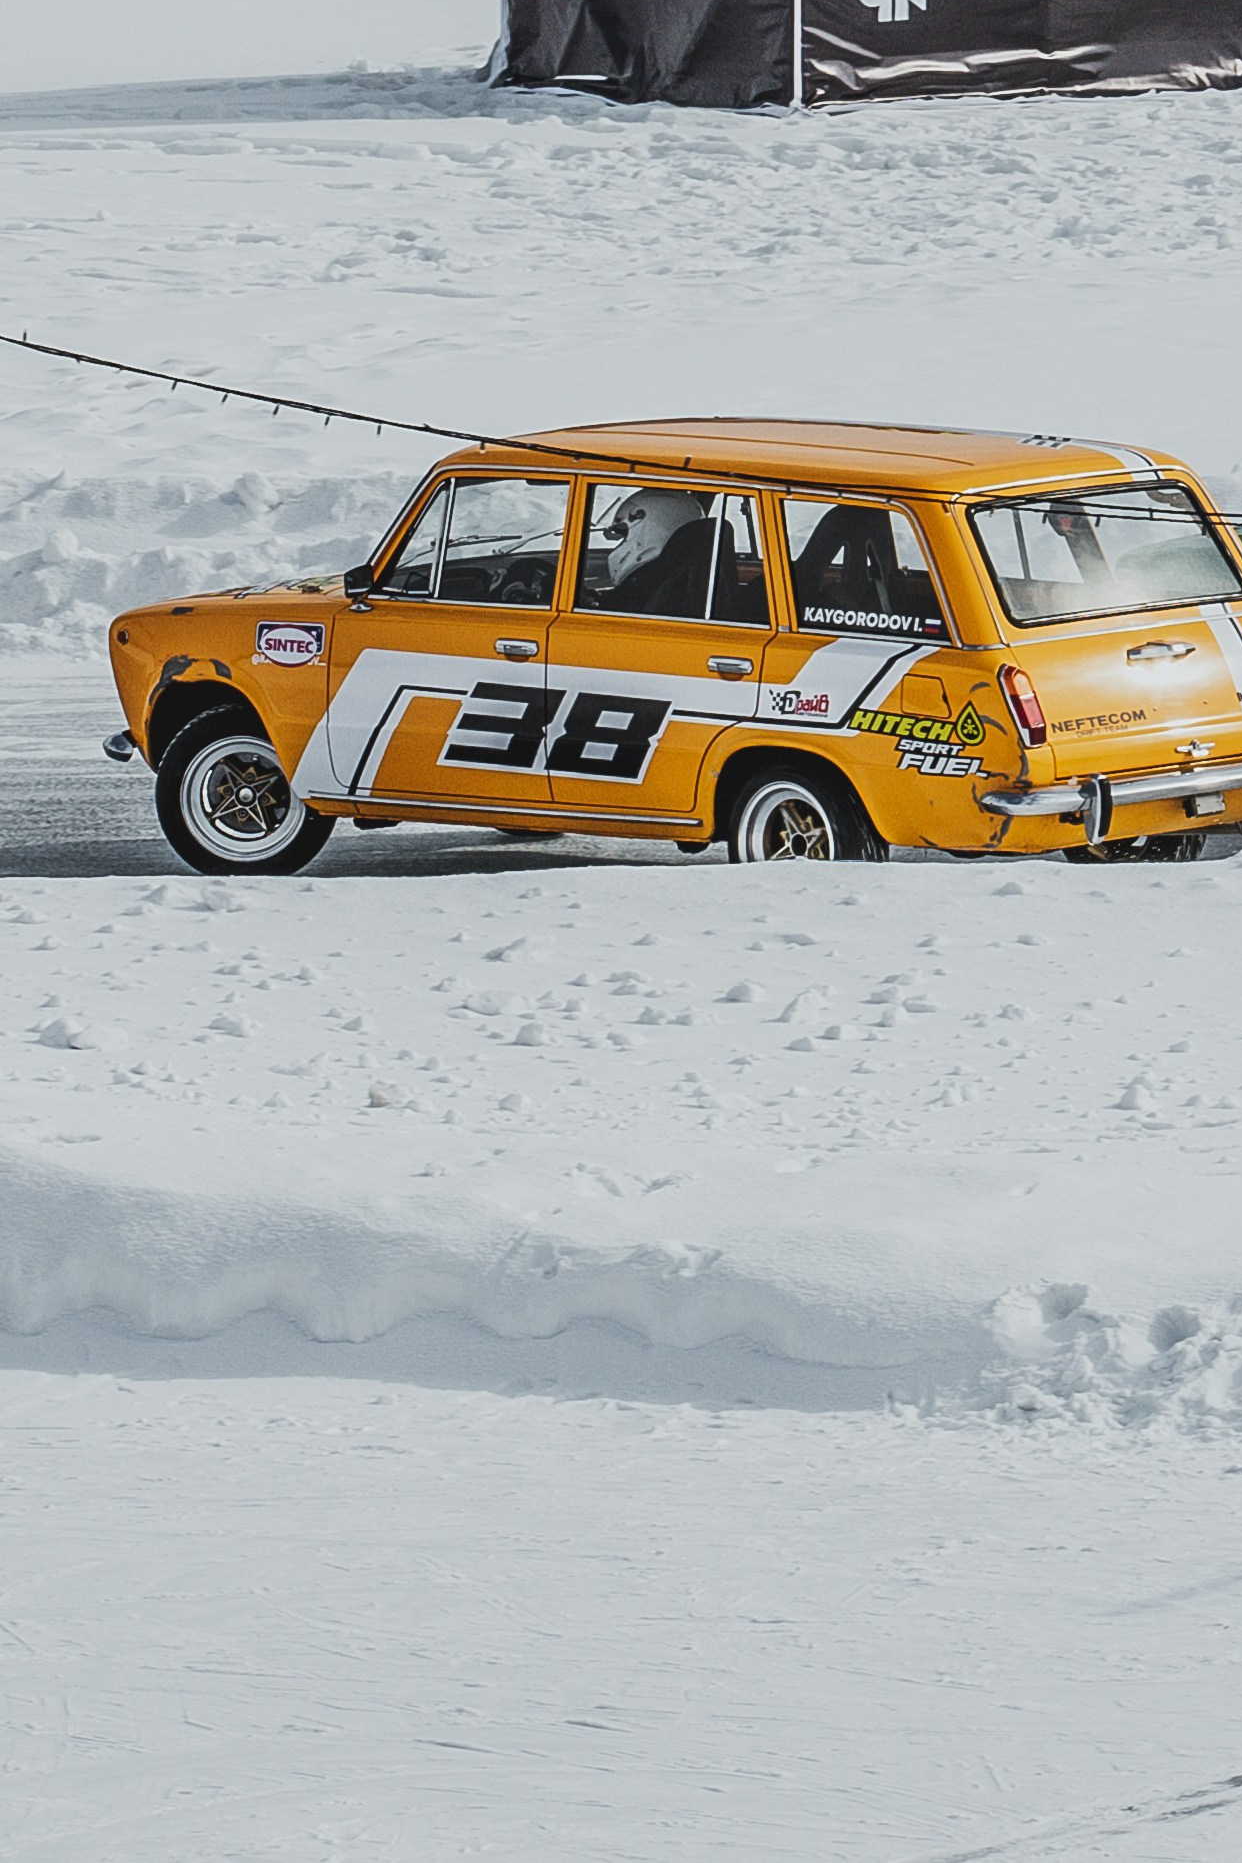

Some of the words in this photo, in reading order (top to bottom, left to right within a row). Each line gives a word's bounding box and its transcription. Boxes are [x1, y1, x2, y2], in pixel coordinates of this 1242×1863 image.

[803, 606, 913, 631] KAYGORODOV
[913, 617, 923, 632] I.
[263, 637, 315, 654] SINTEC
[443, 681, 673, 779] 38
[850, 710, 954, 742] HITECH
[1050, 709, 1147, 734] NEFTECOM
[897, 738, 964, 756] SPORT
[898, 752, 988, 778] FUEL
